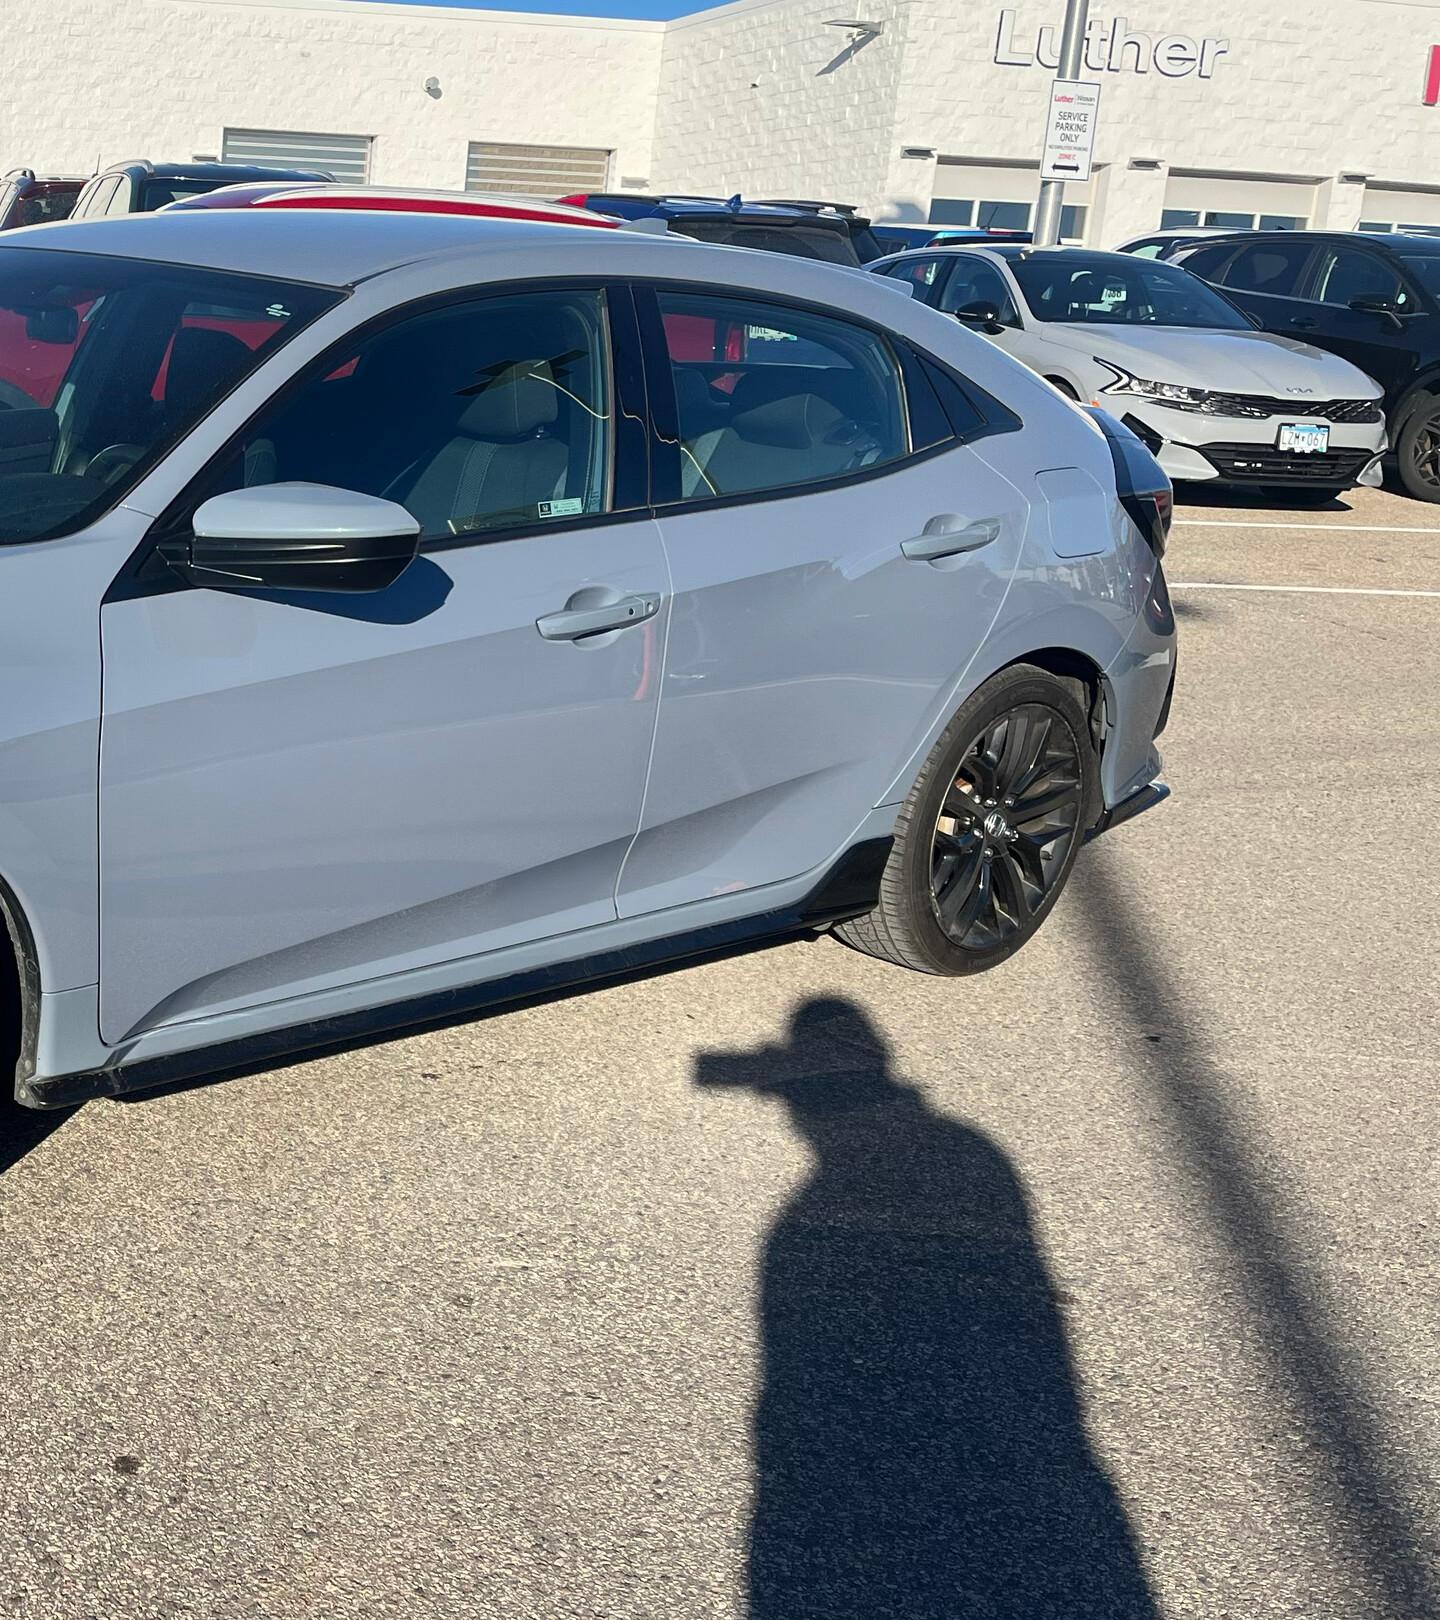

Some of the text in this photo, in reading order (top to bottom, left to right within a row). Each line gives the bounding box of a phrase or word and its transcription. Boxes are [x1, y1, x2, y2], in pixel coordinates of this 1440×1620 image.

[994, 9, 1230, 79] Luther
[1054, 95, 1073, 103] Luther
[1058, 112, 1088, 122] SERVICE
[1055, 122, 1087, 133] PARKING
[1060, 133, 1080, 142] ONLY
